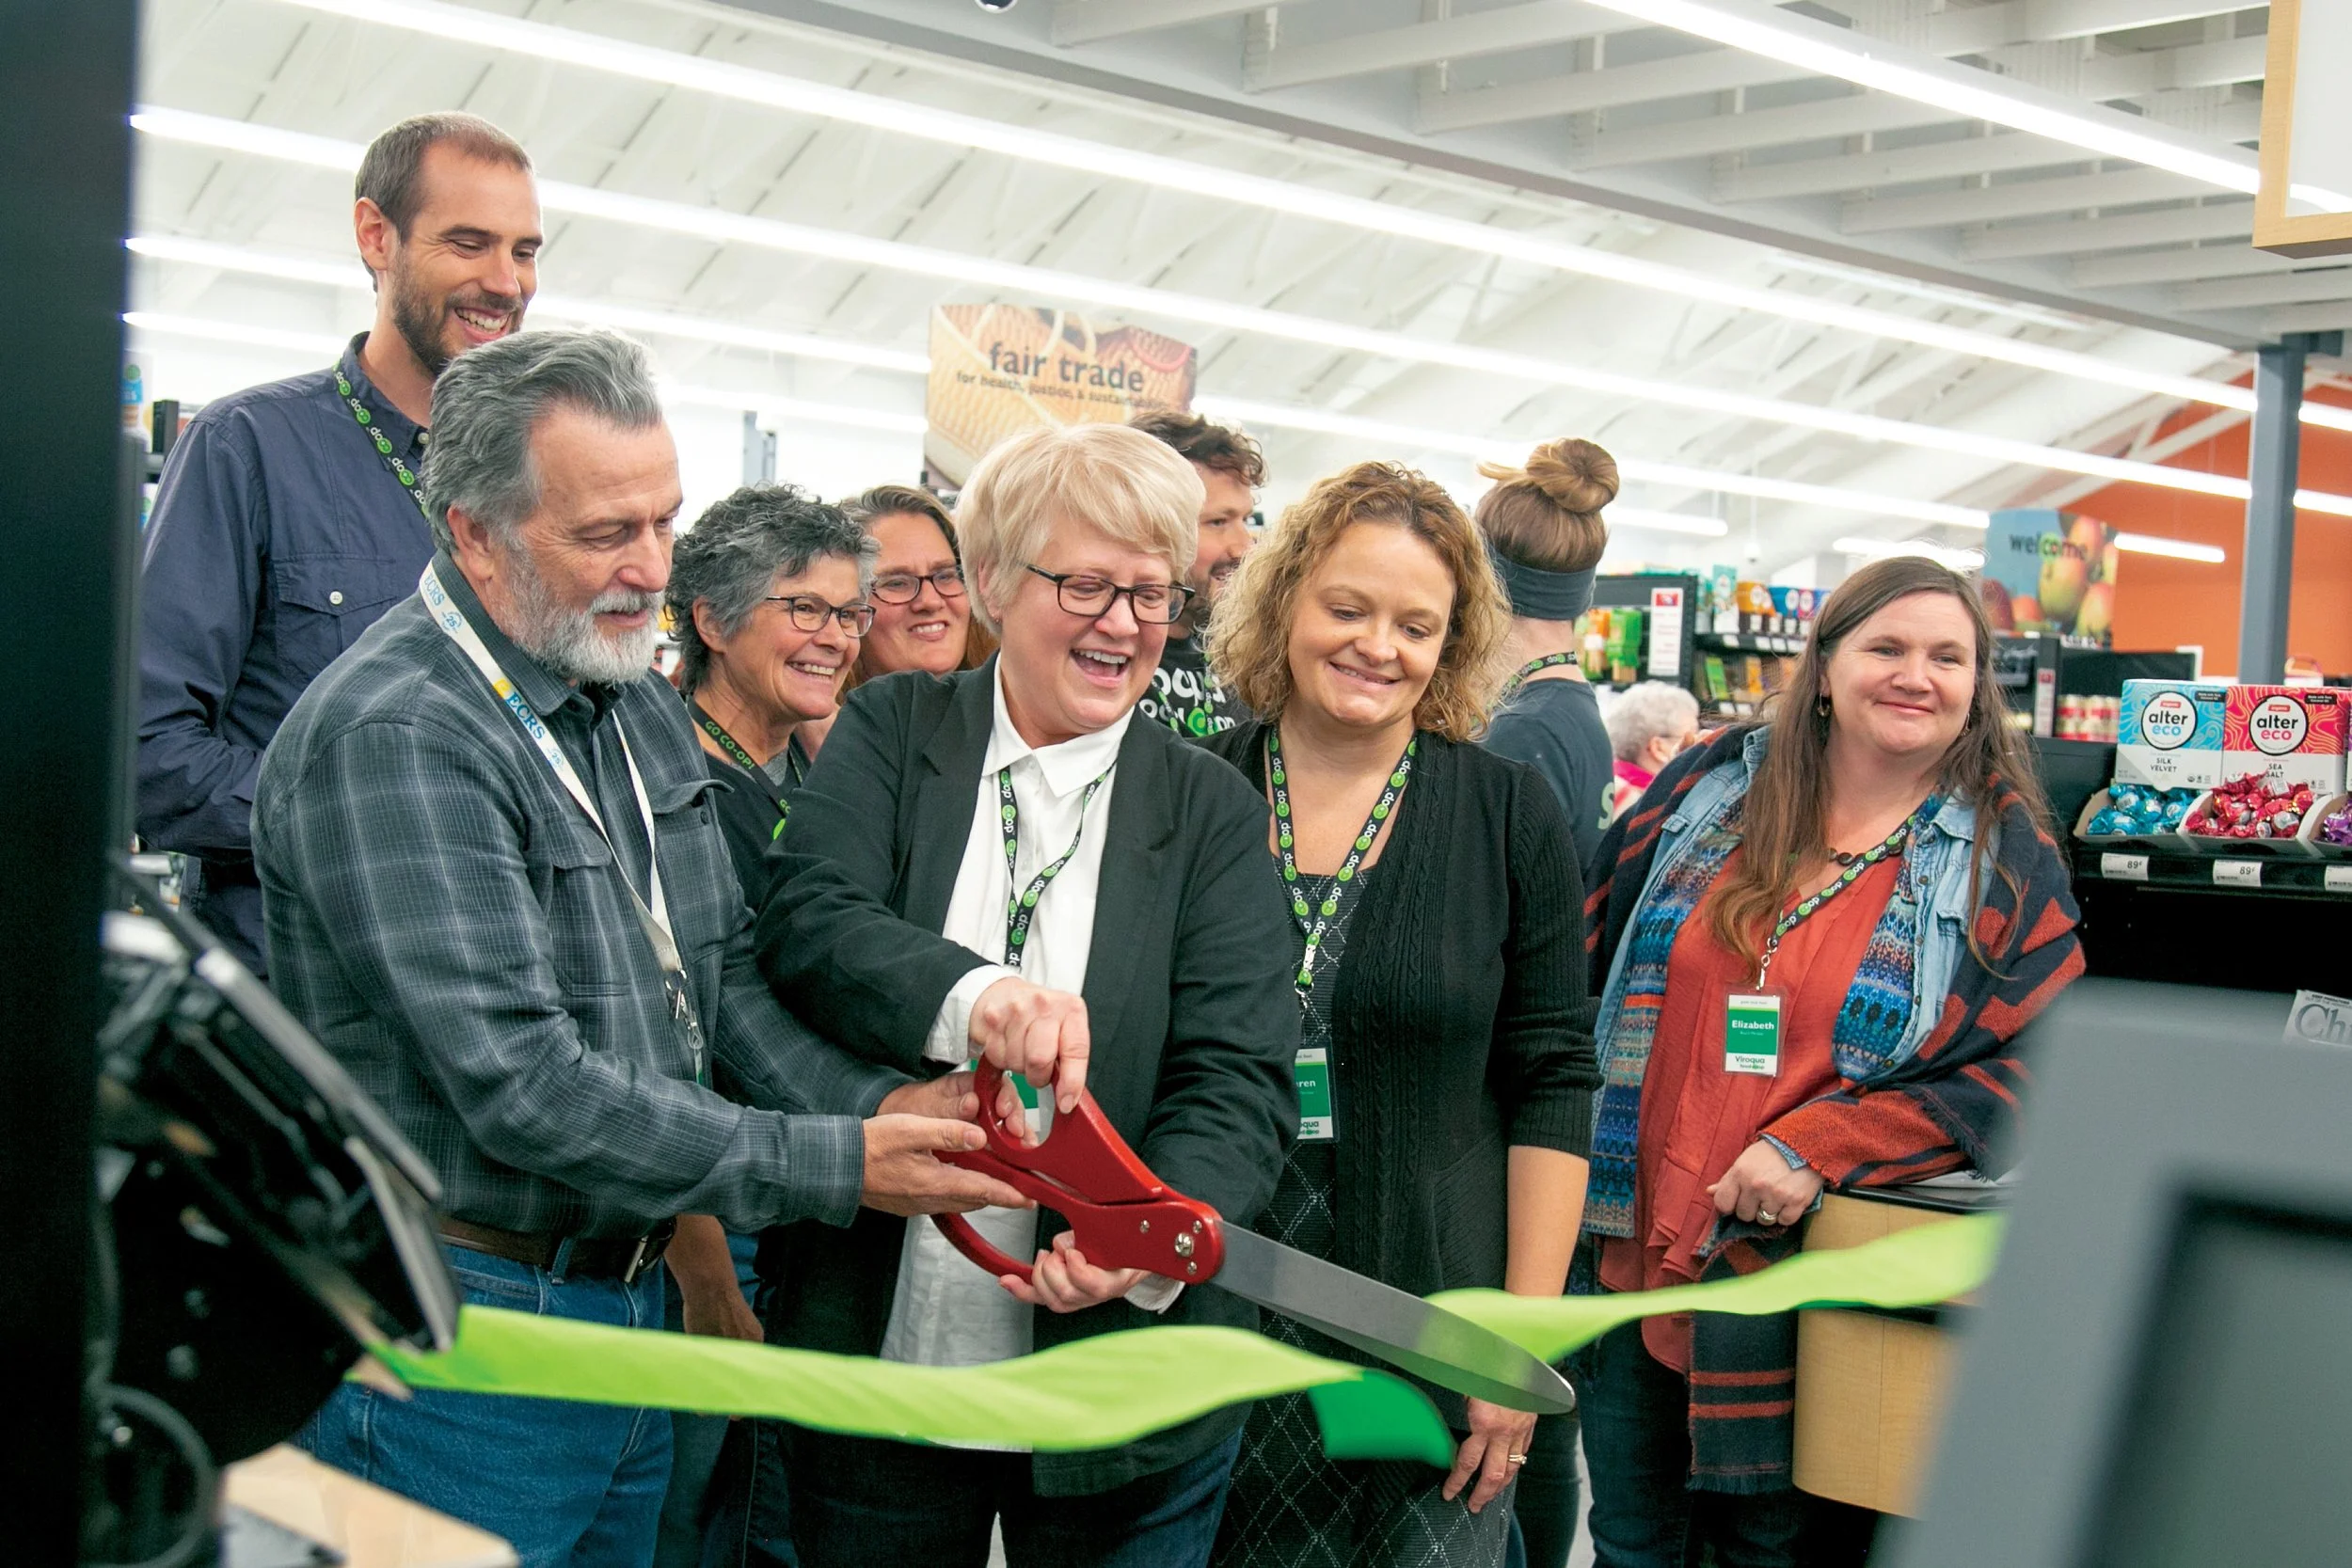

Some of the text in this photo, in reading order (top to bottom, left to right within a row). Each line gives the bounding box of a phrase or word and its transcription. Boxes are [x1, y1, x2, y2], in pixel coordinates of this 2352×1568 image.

[989, 341, 1145, 392] fair trade
[956, 370, 976, 384] for
[423, 575, 445, 607] ECRS
[505, 692, 546, 740] ECRS
[2149, 710, 2188, 725] alter
[2256, 715, 2298, 729] alter
[2152, 724, 2182, 736] eco
[2261, 729, 2292, 740] eco
[706, 721, 755, 769] GO CO-OP!
[1732, 1020, 1774, 1030] Elizabeth
[1735, 1055, 1765, 1064] Viroqua
